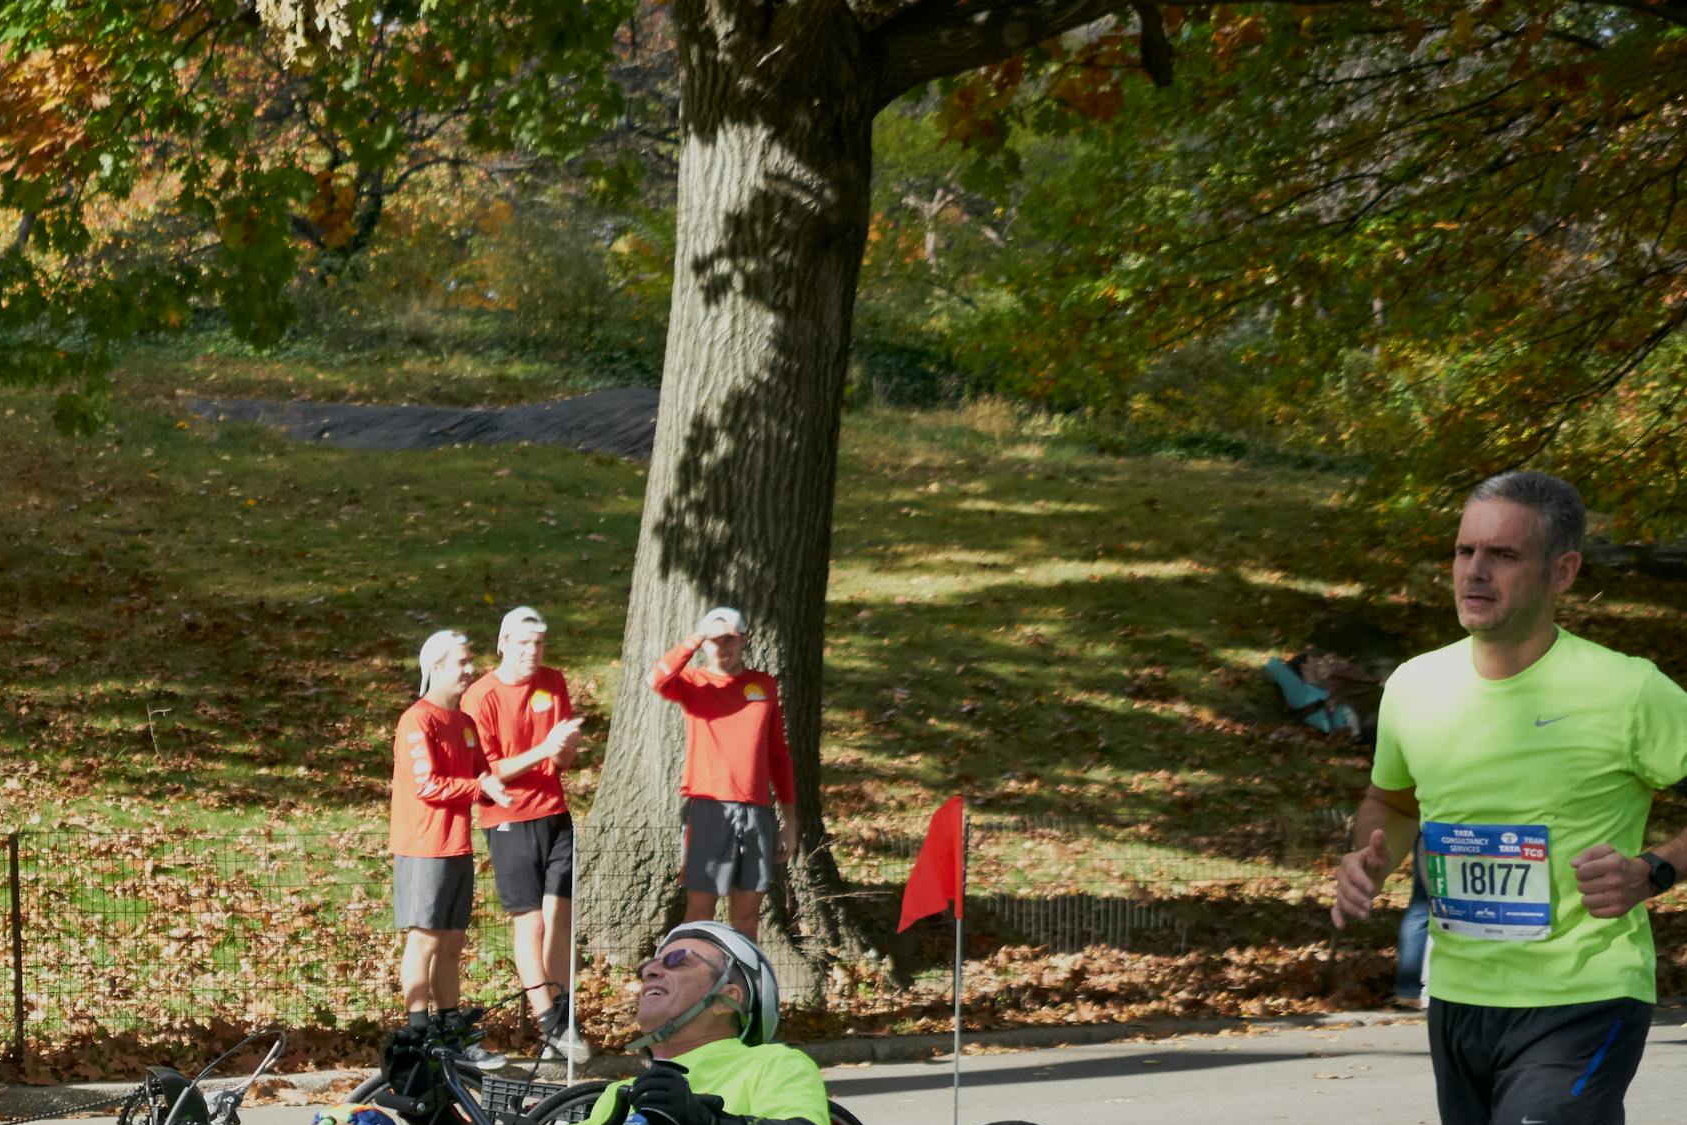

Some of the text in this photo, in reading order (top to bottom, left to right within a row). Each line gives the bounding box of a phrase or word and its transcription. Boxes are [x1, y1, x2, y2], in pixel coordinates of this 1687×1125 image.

[1454, 829, 1474, 837] TATA
[1441, 836, 1489, 846] CONSULTANCY
[1524, 836, 1545, 844] TEAM
[1449, 845, 1481, 853] SERVICES
[1499, 845, 1521, 853] TATA
[1524, 847, 1544, 858] TCS
[1461, 861, 1531, 897] 18177
